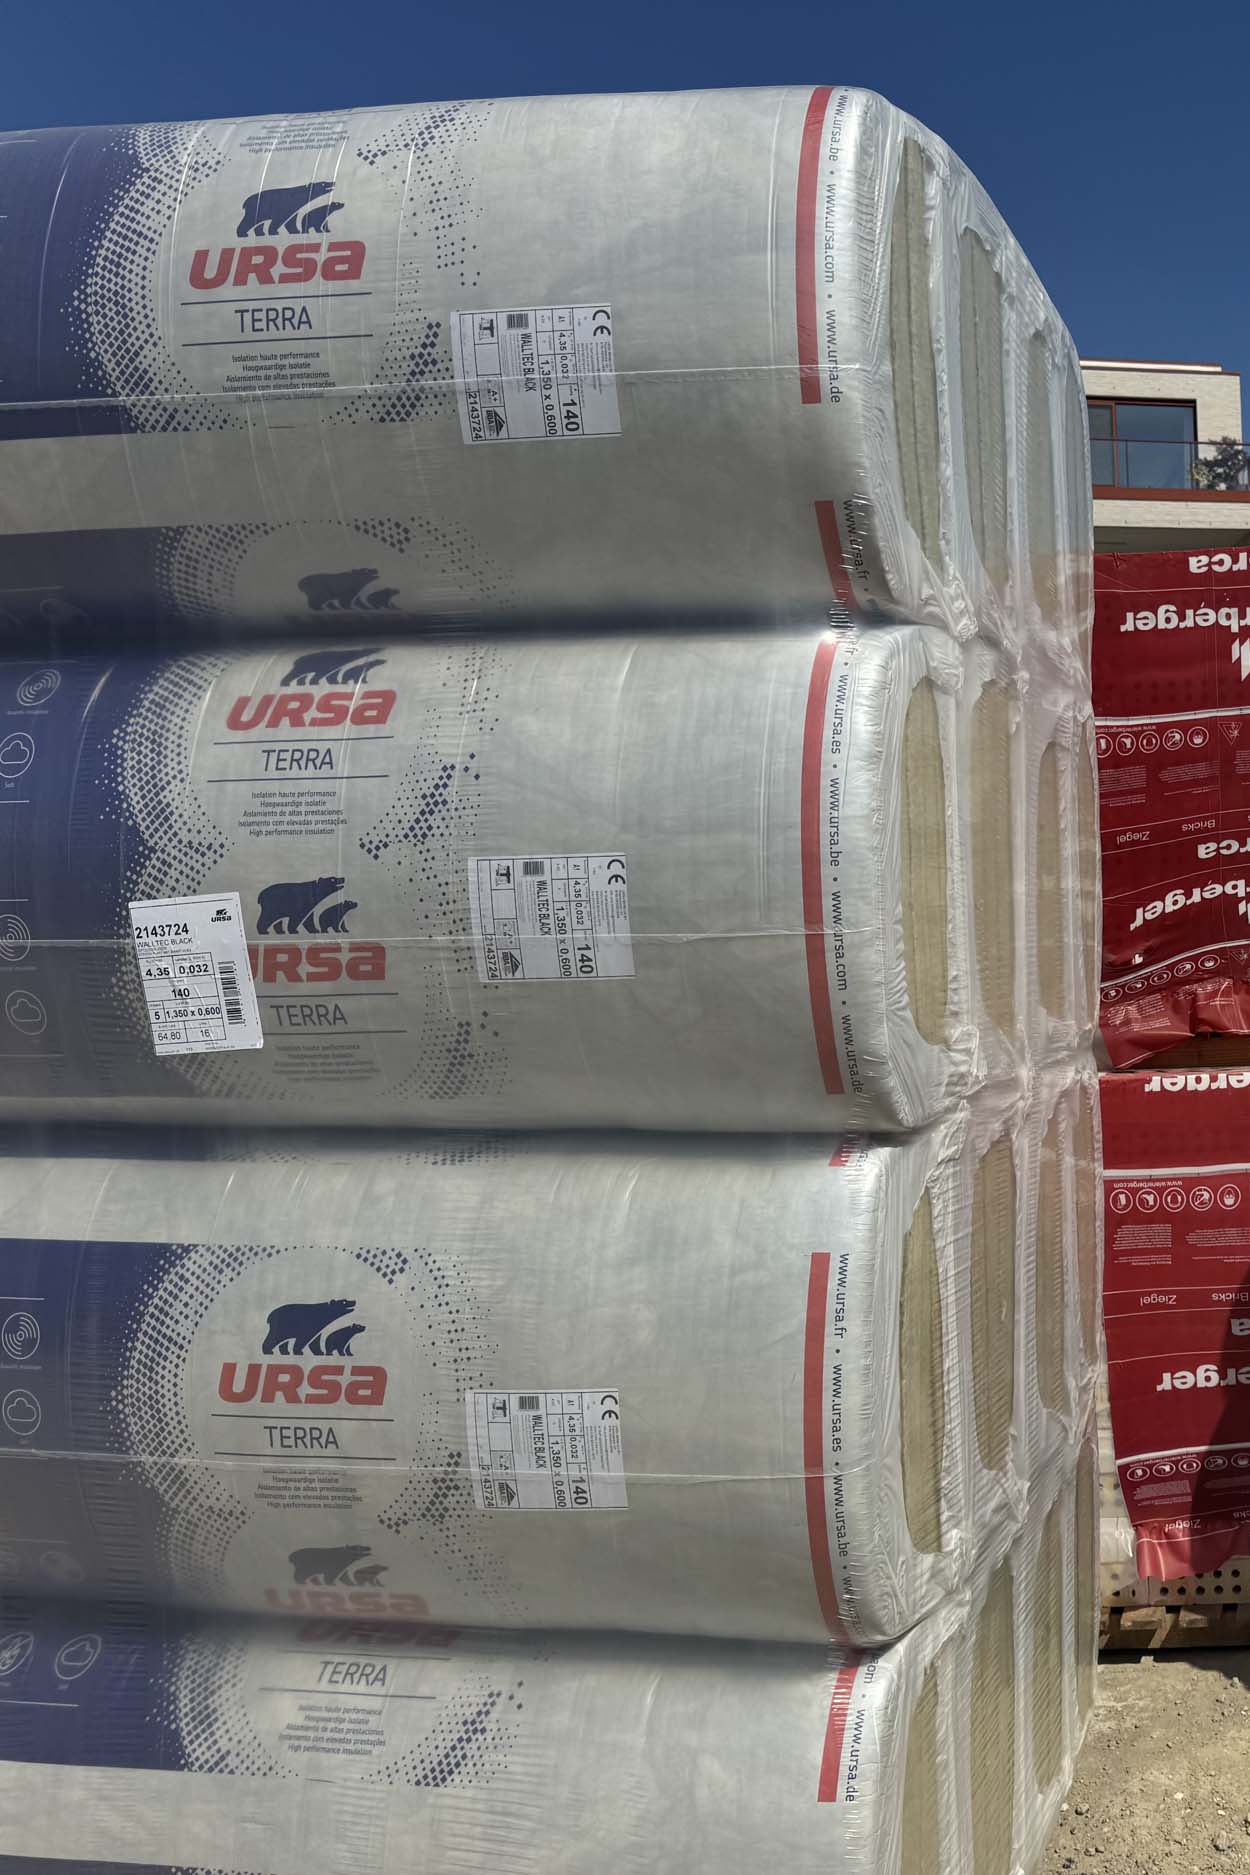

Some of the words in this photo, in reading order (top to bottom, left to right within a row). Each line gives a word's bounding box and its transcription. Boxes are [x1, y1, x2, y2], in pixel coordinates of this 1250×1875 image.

[829, 93, 849, 162] www.ursa.be
[823, 183, 836, 284] www.ursa.com
[234, 305, 313, 333] TERRA
[520, 332, 535, 367] WALLTEC
[558, 332, 567, 352] 4,35
[231, 353, 259, 363] Isolation
[260, 352, 277, 361] haute
[279, 350, 320, 362] performance
[825, 309, 841, 404] www.ursa.de
[263, 373, 272, 381] de
[273, 372, 289, 381] altas
[289, 370, 330, 382] prestaciones
[540, 360, 553, 392] 1,350
[468, 392, 483, 440] 2143724
[544, 404, 558, 435] 0,600
[563, 399, 580, 432] 140
[830, 674, 849, 755] www.ursa.es
[262, 747, 335, 772] TERRA
[251, 791, 277, 799] Isolation
[278, 790, 296, 799] haute
[296, 789, 337, 800] performance
[271, 819, 286, 827] com
[278, 809, 287, 817] de
[287, 808, 303, 817] altas
[304, 807, 344, 818] prestaciones
[828, 777, 843, 868] www.ursa.be
[249, 829, 264, 838] High
[264, 828, 304, 838] performance
[1116, 830, 1150, 846] Ziegel
[1182, 818, 1216, 833] Bricks
[536, 879, 550, 913] WALLTEC
[572, 880, 582, 899] 4,35
[538, 913, 553, 936] BLACK
[554, 906, 568, 936] 1,350
[575, 902, 584, 926] 0,032
[134, 923, 190, 940] 2143724
[136, 938, 170, 948] WALLTEC
[170, 937, 193, 946] BLACK
[830, 890, 848, 991] www.ursa.com
[178, 963, 209, 976] 0,032
[484, 935, 499, 979] 2143724
[559, 948, 573, 977] 0,600
[577, 944, 594, 976] 140
[171, 987, 190, 999] 140
[153, 1011, 161, 1021] 5
[165, 1008, 189, 1019] 1,350
[197, 1006, 221, 1017] 0,600
[269, 1003, 348, 1027] TERRA
[200, 1029, 210, 1038] 16
[841, 1013, 864, 1094] www.ursa.de
[1113, 1180, 1183, 1189] www.wienerberger.com
[834, 1252, 850, 1340] www.ursa.fr
[1140, 1294, 1177, 1308] Ziegel
[1212, 1290, 1249, 1303] Bricks
[831, 1363, 843, 1453] www.ursa.es
[531, 1414, 545, 1444] WALLTEC
[567, 1415, 577, 1433] 4,35
[263, 1425, 340, 1449] TERRA
[571, 1436, 579, 1460] 0,032
[534, 1444, 548, 1469] BLACK
[550, 1440, 563, 1468] 1,350
[555, 1480, 567, 1508] 0,600
[571, 1476, 589, 1506] 140
[833, 1473, 849, 1558] www.ursa.be
[317, 1661, 388, 1687] TERRA
[845, 1708, 866, 1803] www.ursa.de
